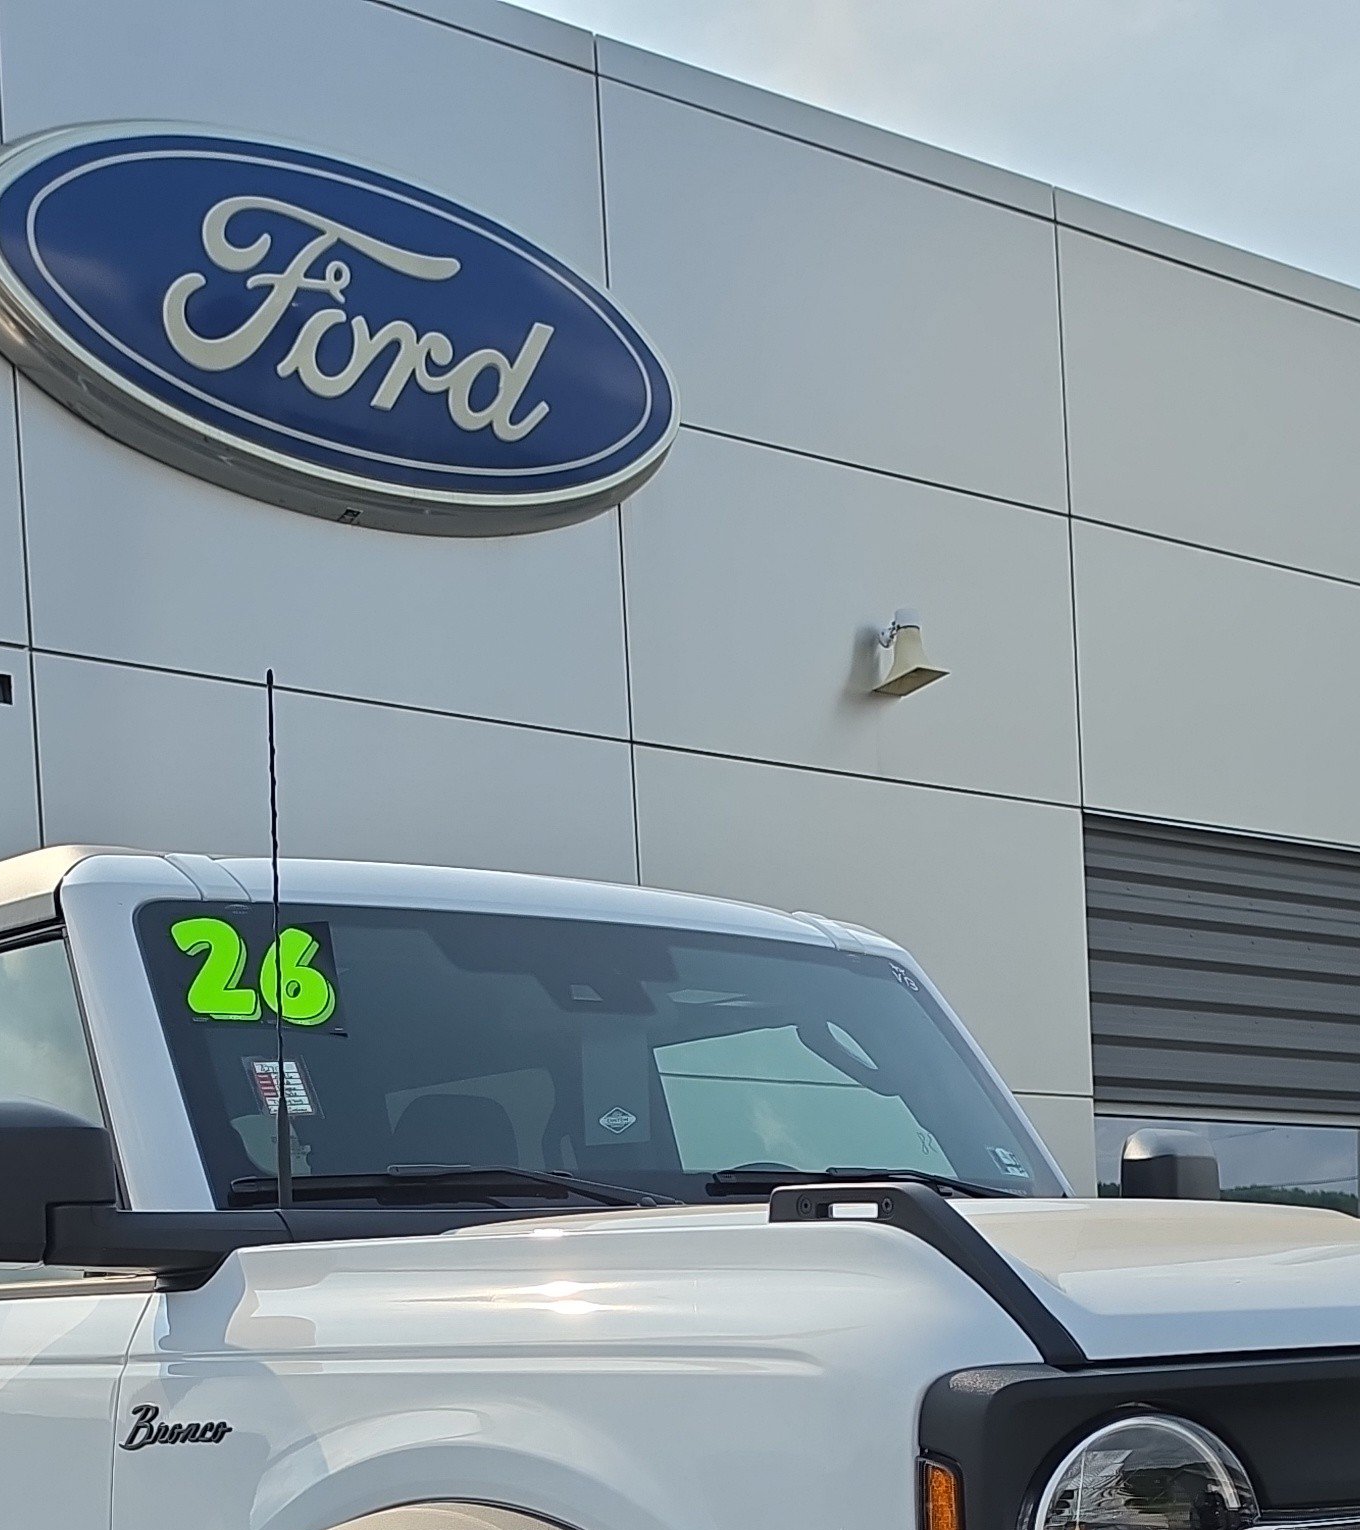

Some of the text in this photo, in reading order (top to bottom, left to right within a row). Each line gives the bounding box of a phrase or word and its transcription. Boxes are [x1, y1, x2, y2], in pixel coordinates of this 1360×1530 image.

[162, 196, 554, 442] Ford
[170, 917, 336, 1027] 26
[118, 1403, 233, 1451] Bronco
